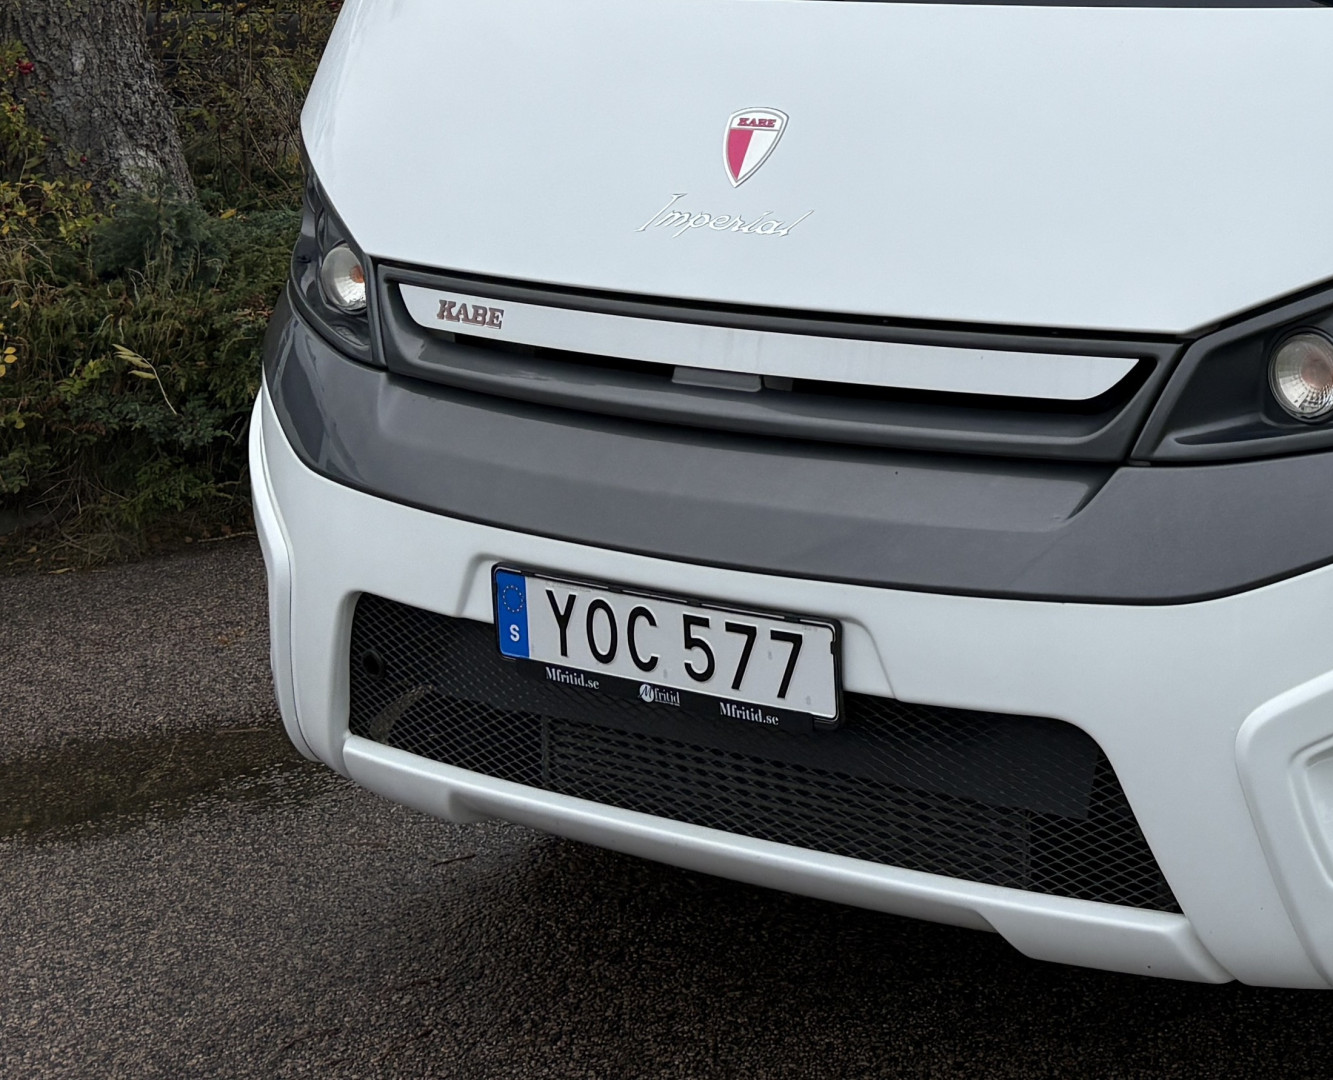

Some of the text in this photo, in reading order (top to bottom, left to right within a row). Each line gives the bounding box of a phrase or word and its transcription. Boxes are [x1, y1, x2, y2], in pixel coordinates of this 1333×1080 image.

[737, 117, 777, 128] KABE
[634, 193, 815, 239] Imperial
[437, 299, 505, 330] KABE
[509, 624, 520, 642] S
[545, 588, 804, 700] YOC 577
[545, 666, 600, 690] Mfritid.se
[719, 701, 779, 726] Mfritid.se
